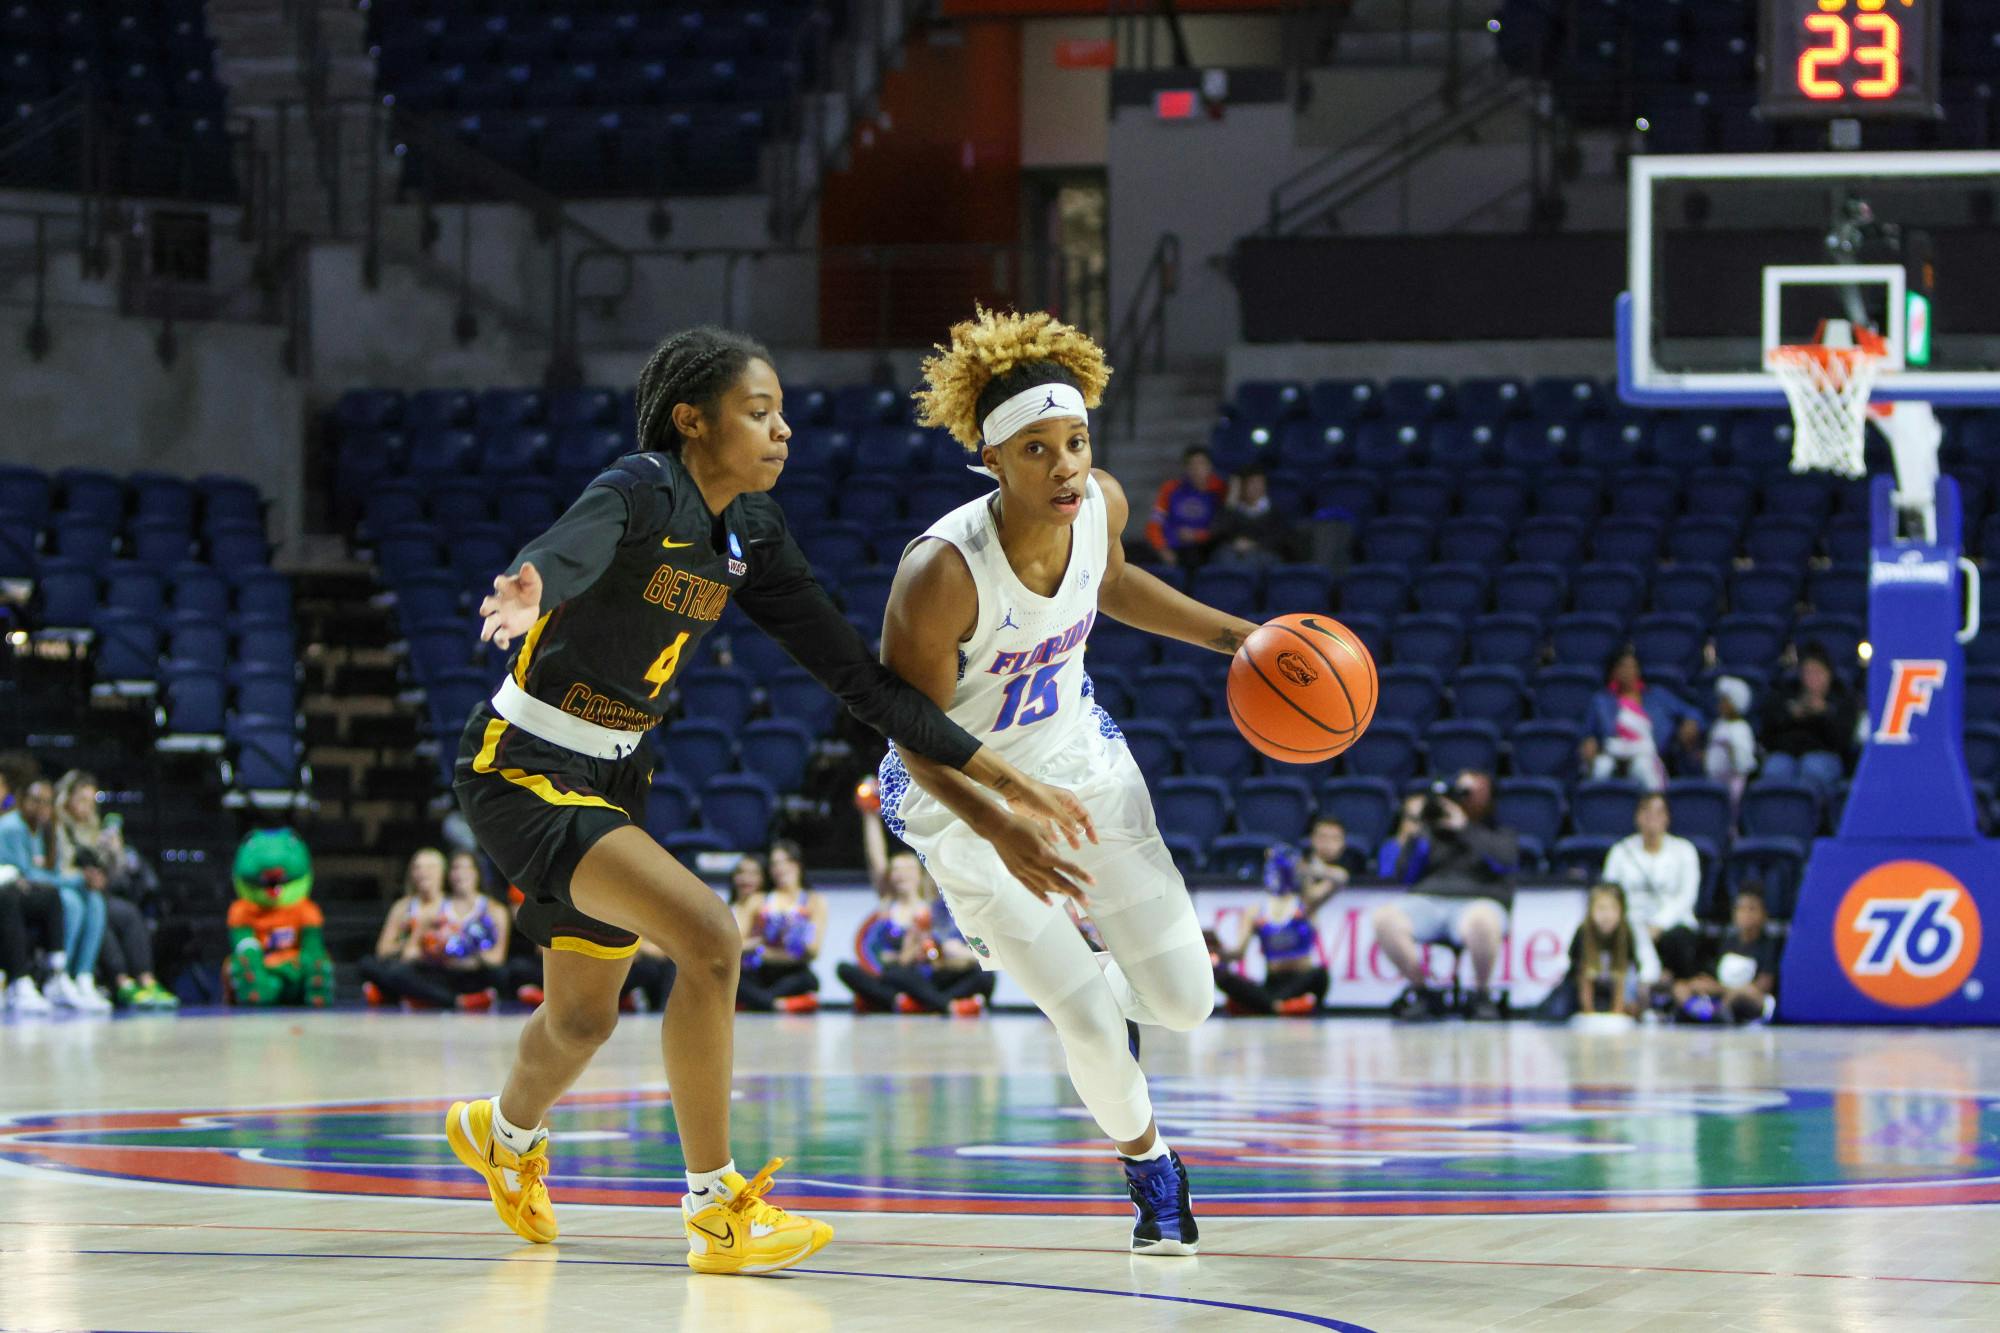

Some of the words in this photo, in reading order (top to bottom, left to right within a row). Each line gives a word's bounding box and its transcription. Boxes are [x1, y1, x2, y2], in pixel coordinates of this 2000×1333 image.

[1797, 13, 1902, 99] 23
[728, 558, 747, 576] WAC
[642, 631, 690, 700] 4
[990, 657, 1071, 733] 15
[1872, 659, 1948, 745] F
[1852, 888, 1961, 978] 76
